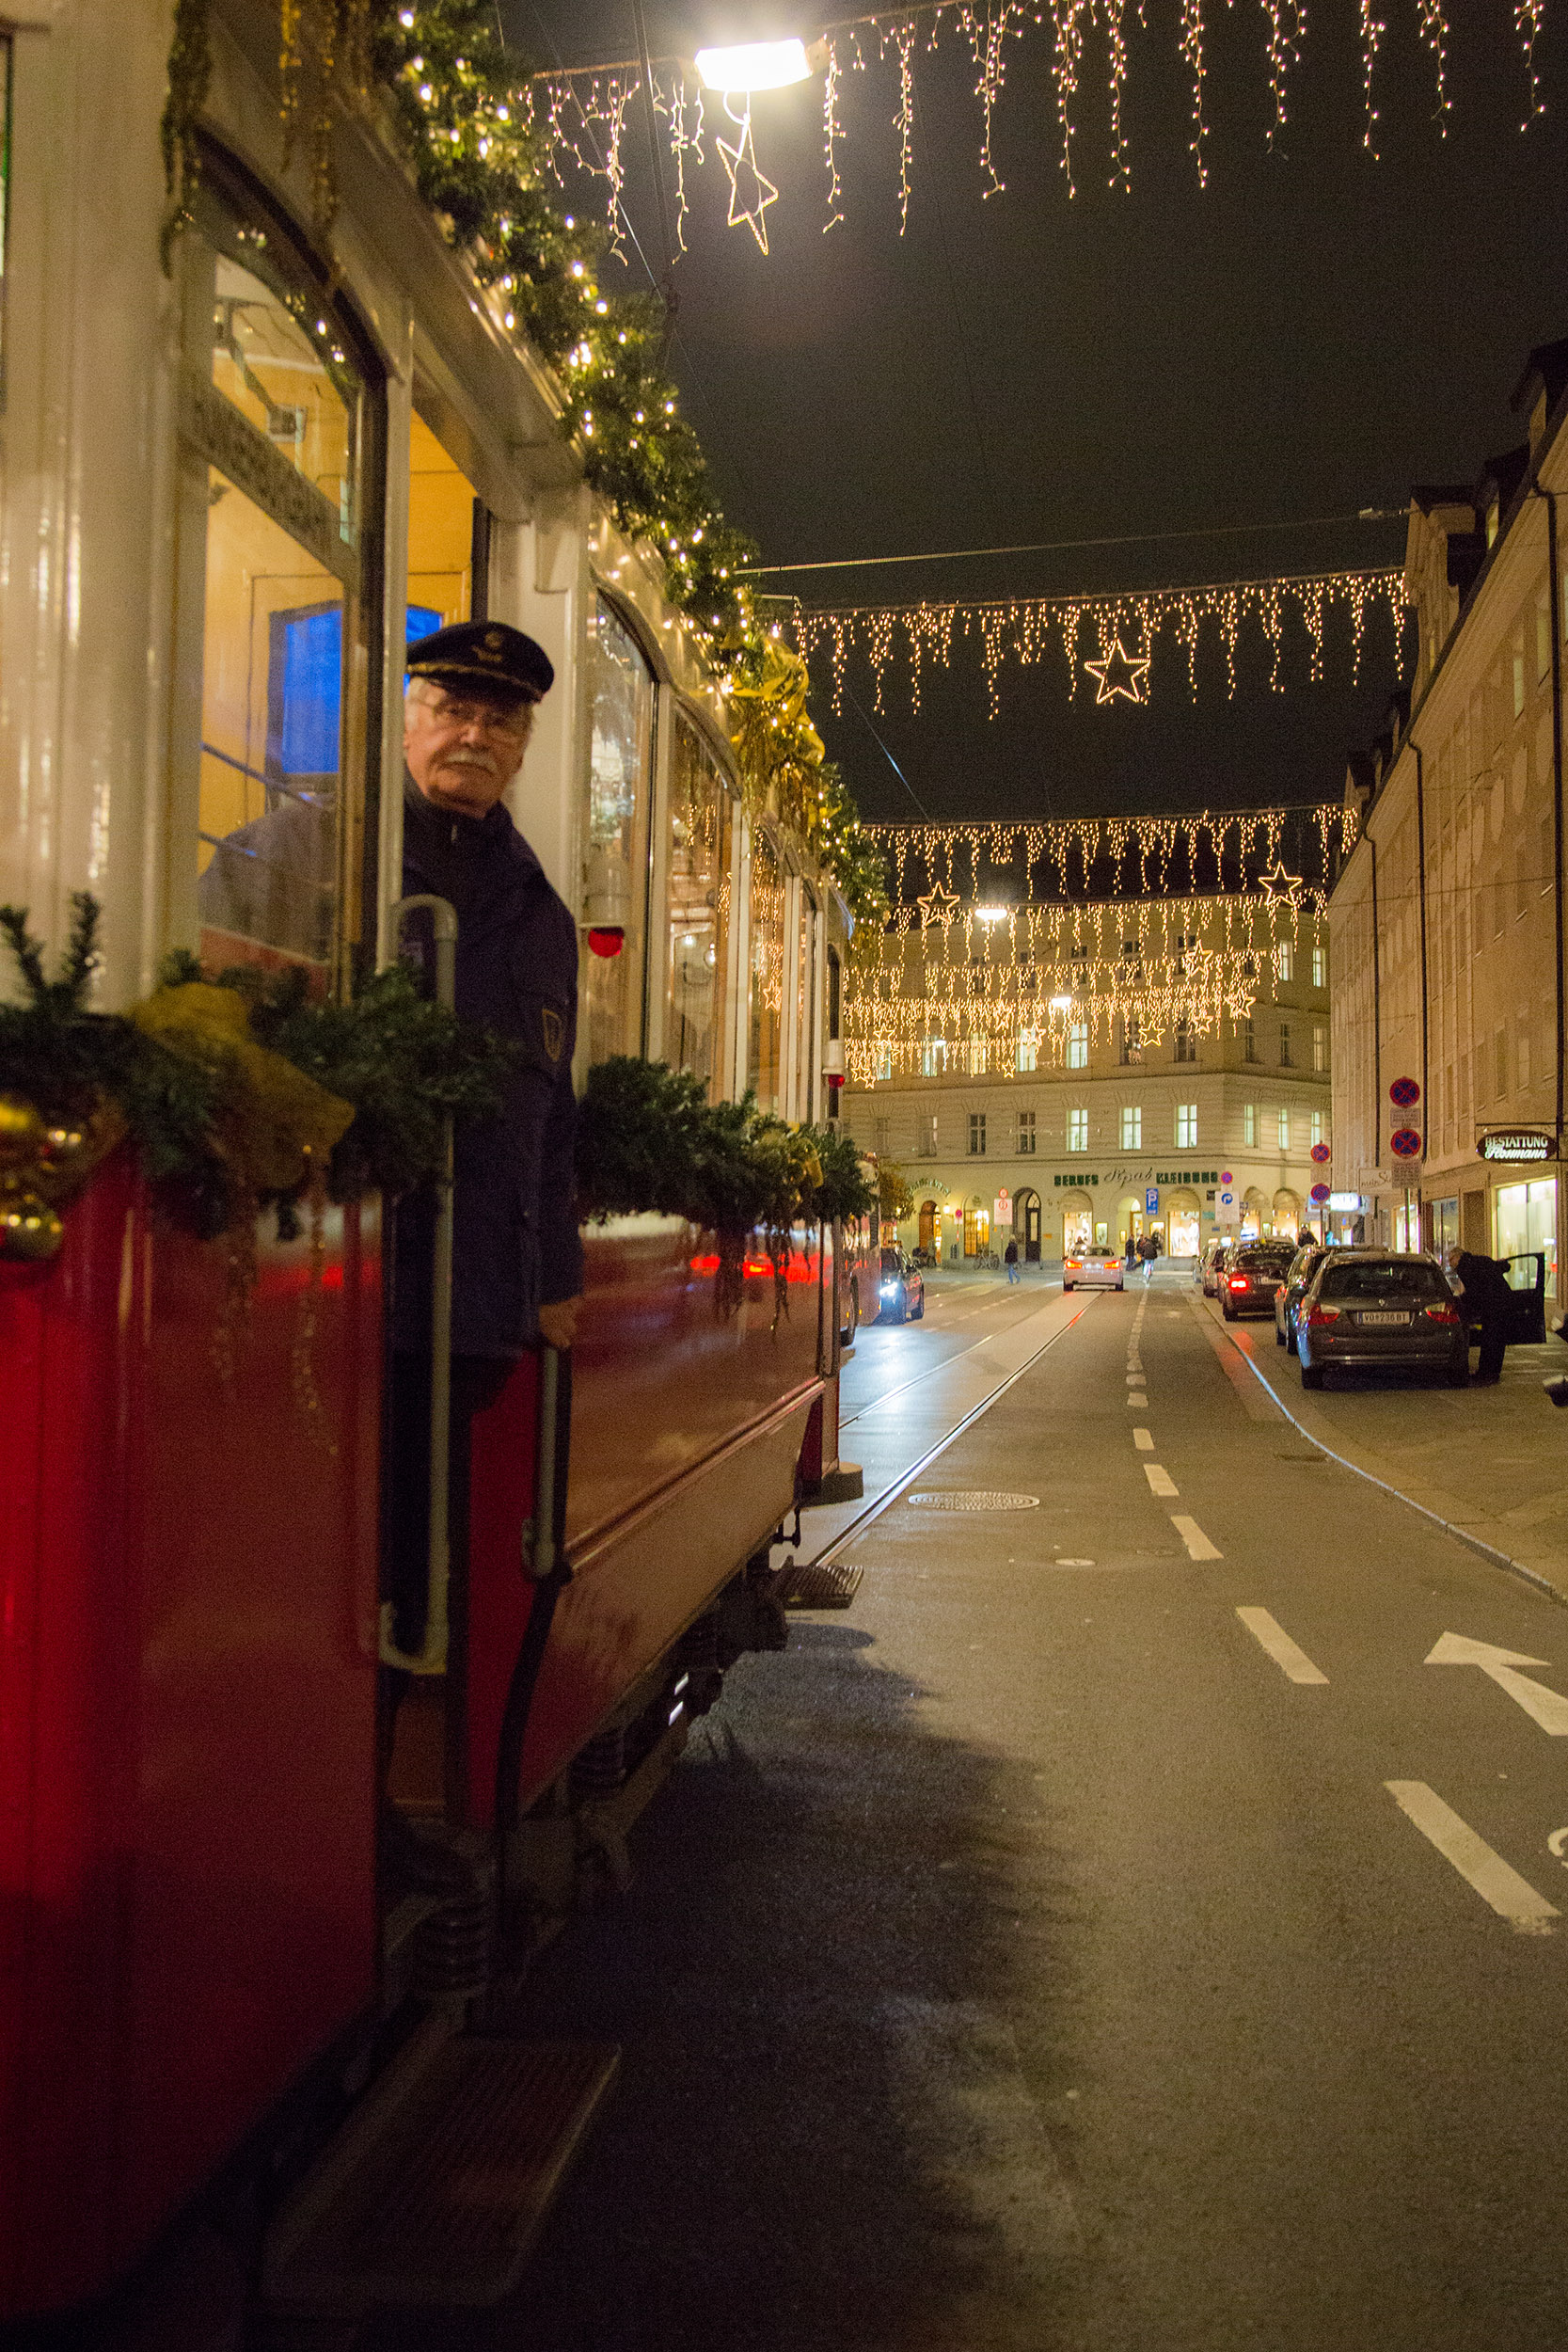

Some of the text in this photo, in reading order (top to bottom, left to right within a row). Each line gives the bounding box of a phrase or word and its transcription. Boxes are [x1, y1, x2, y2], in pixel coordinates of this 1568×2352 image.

[1485, 1136, 1548, 1149] BESTATTUNG
[1053, 1174, 1099, 1186] BERUFS
[1156, 1171, 1218, 1184] KLEIDUNG
